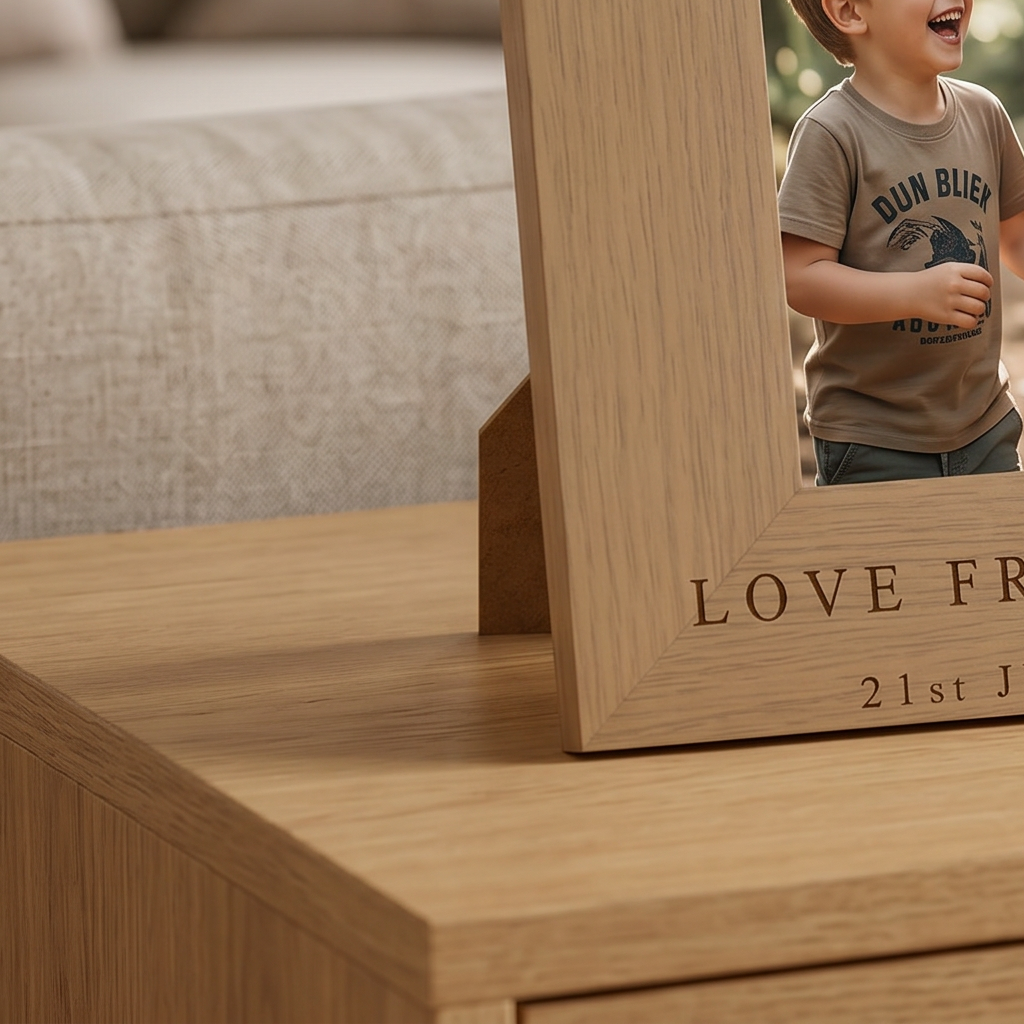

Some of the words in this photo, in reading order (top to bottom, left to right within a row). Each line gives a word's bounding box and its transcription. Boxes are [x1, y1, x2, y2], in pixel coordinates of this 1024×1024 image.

[872, 172, 930, 224] DUN
[691, 565, 902, 627] LOVE
[861, 676, 967, 709] 21st
